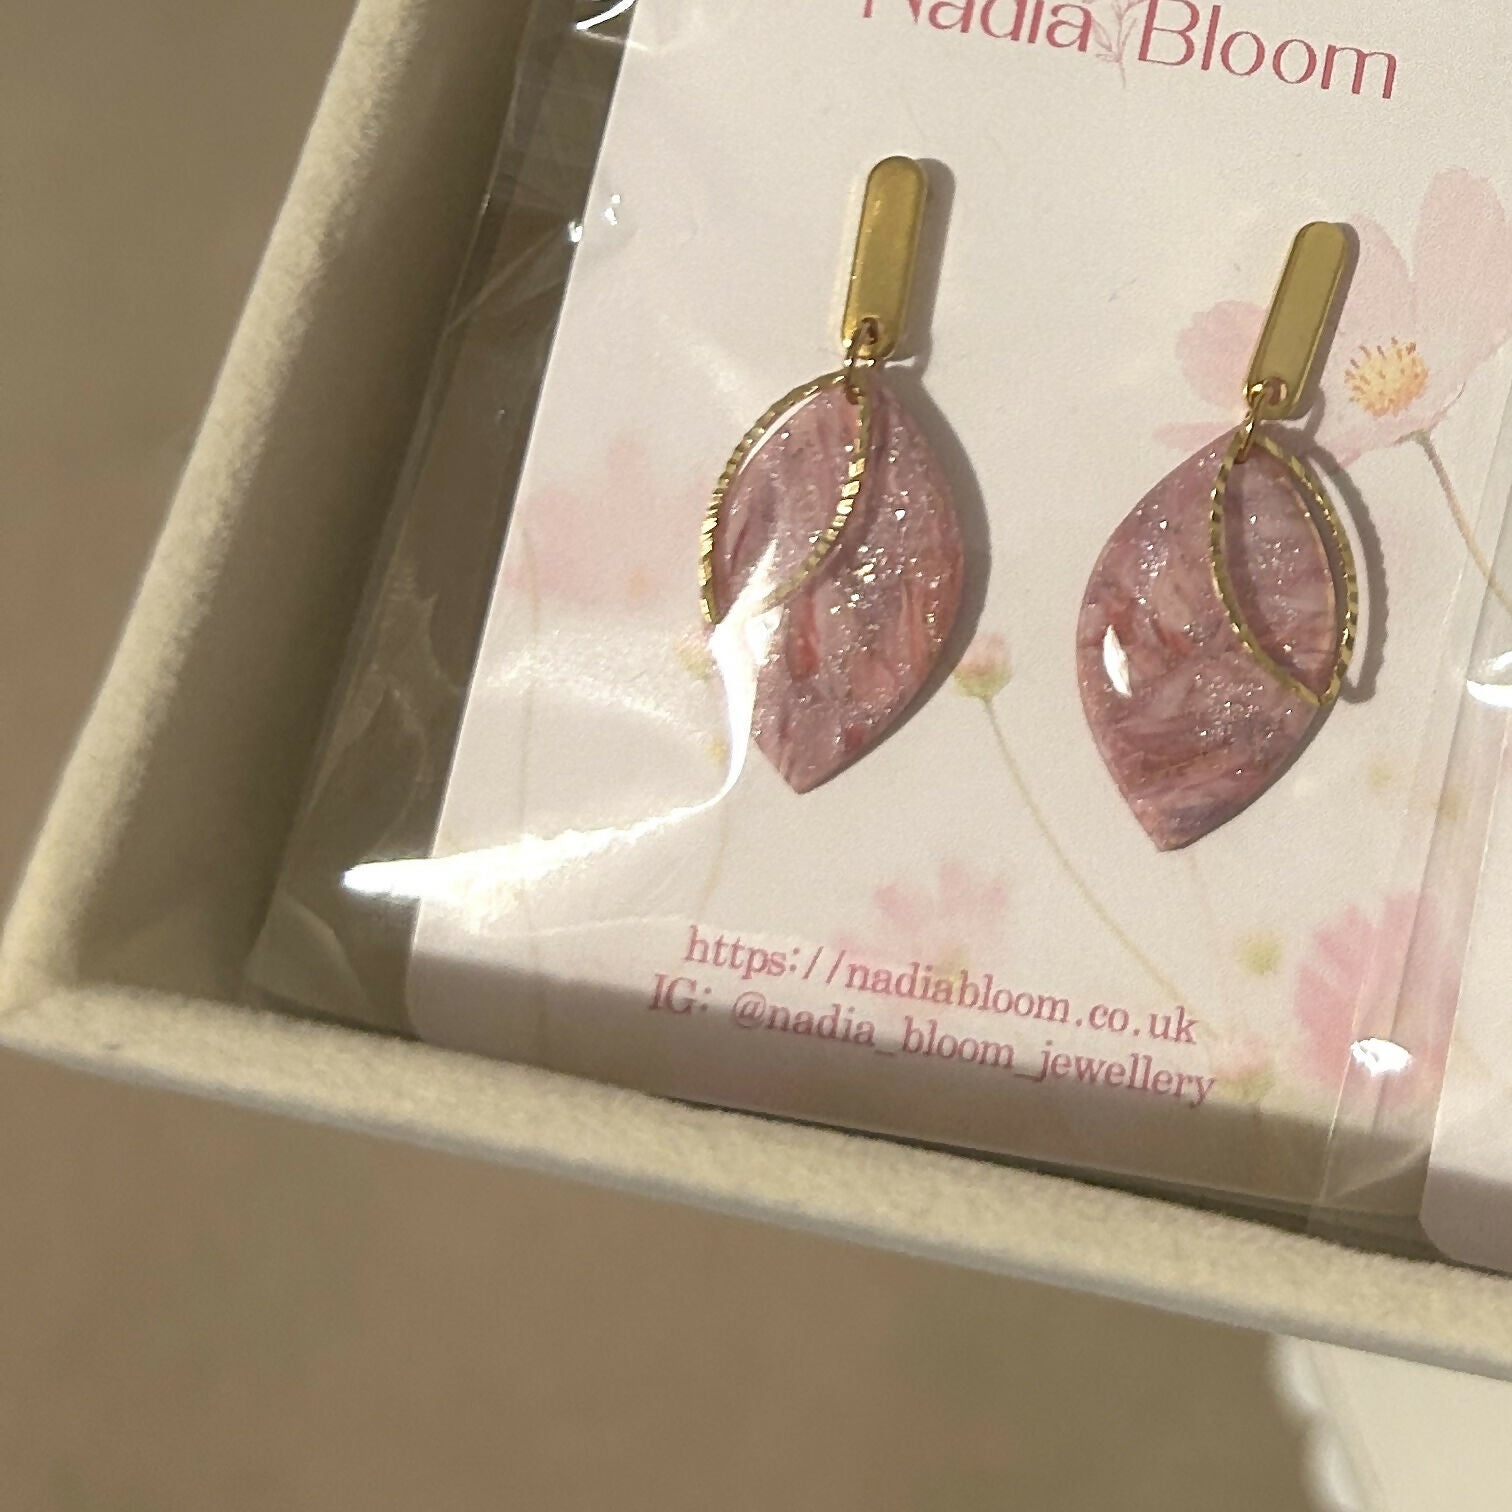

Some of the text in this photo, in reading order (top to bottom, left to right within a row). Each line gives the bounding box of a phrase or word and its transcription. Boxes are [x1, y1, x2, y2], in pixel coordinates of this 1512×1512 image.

[648, 973, 1217, 1107] IG: @nadia_bloom_jewellery
[685, 926, 1199, 1044] https://nadiabloom.co.uk
